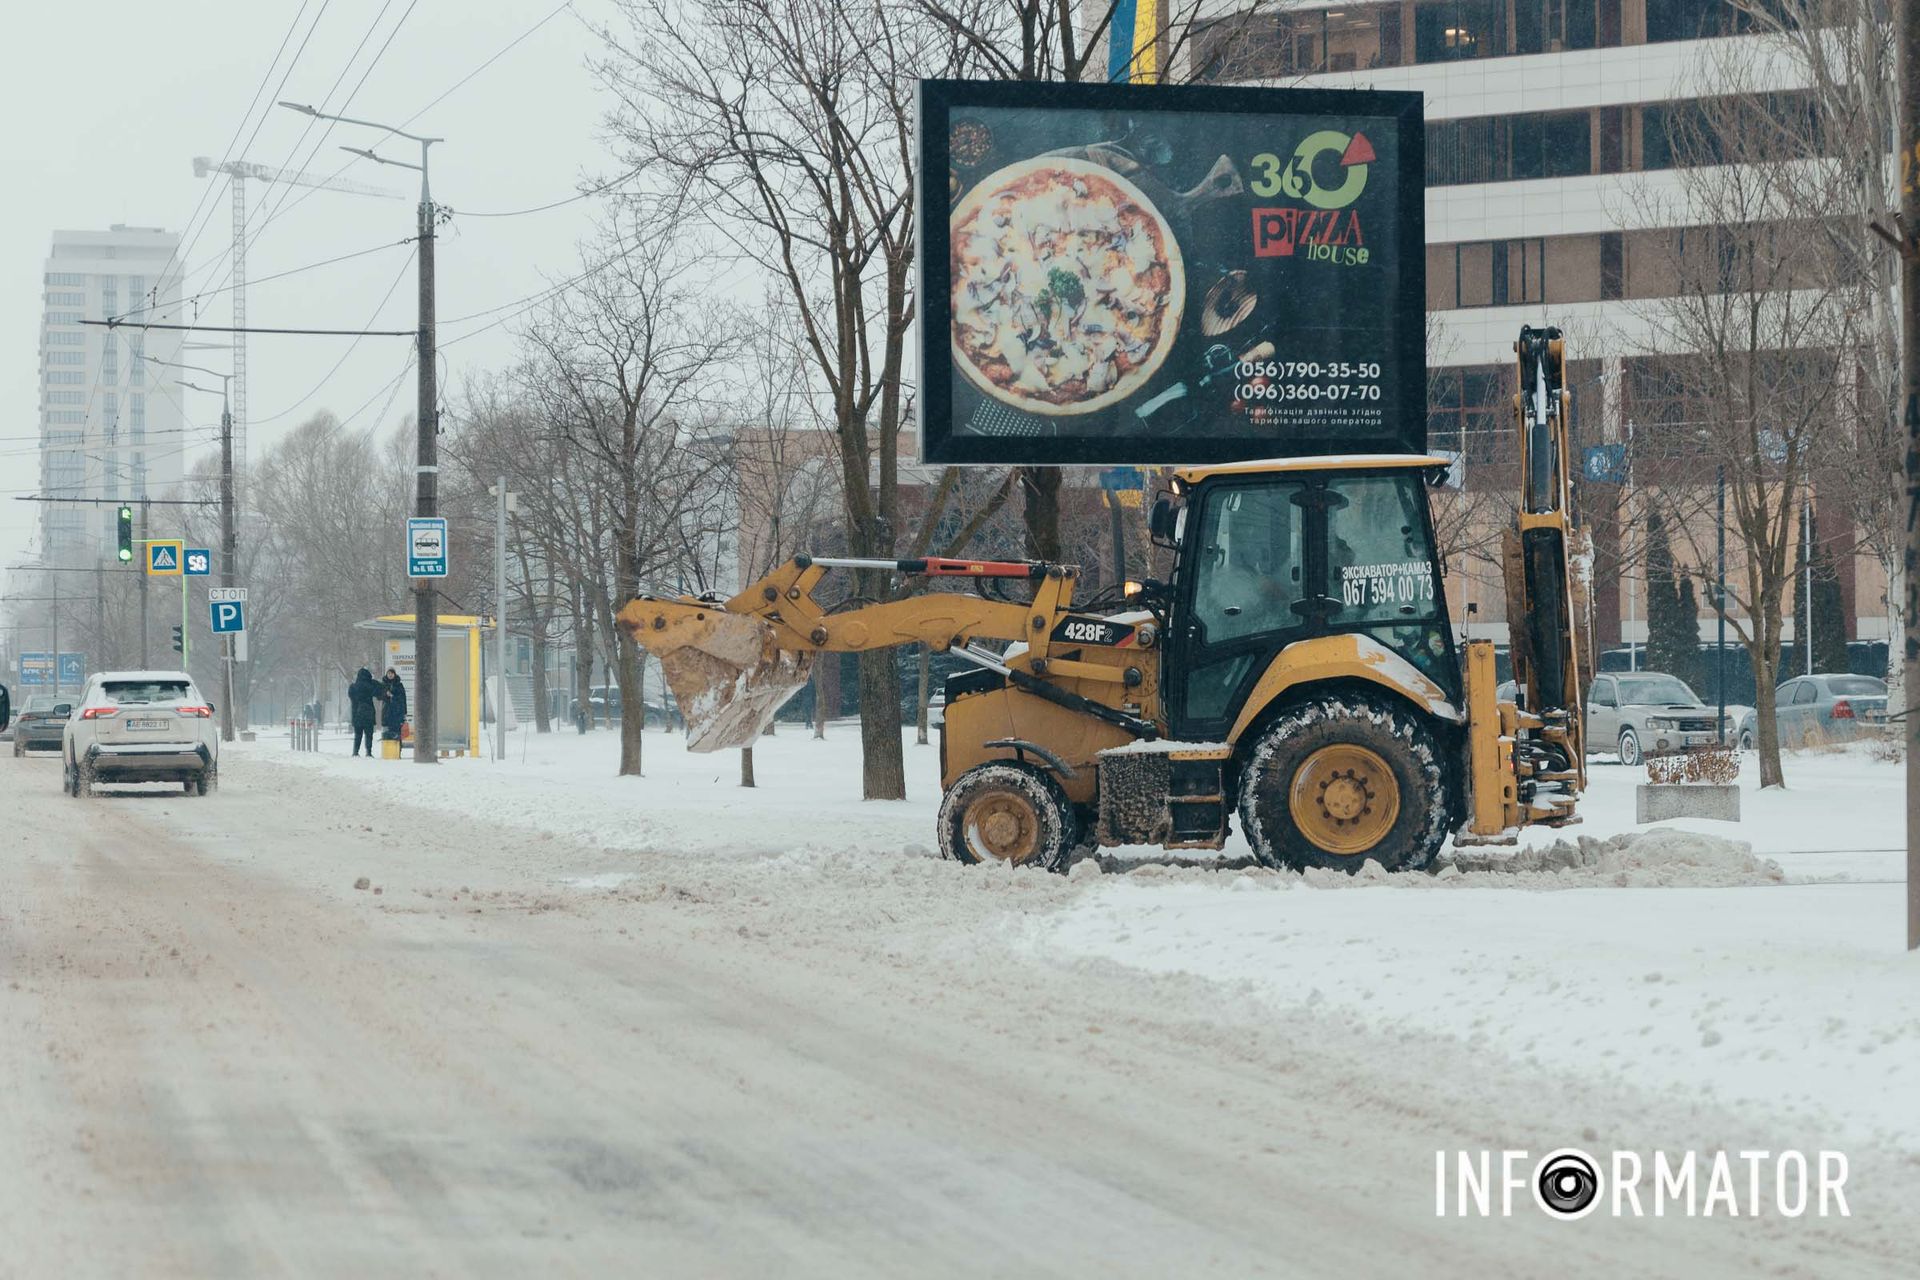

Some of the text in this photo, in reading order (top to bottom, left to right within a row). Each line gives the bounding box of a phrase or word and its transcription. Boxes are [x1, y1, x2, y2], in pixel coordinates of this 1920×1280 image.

[1250, 130, 1376, 209] 360
[1234, 361, 1381, 380] (056)790-35-50
[1234, 384, 1381, 402] (096)360-07-70
[1244, 407, 1382, 416] Тарифікація дзвінків згідно
[1249, 417, 1289, 426] тарифів
[1330, 418, 1382, 426] оператора
[1342, 561, 1433, 580] ЭКСКАВАТОР+КАМАЗ
[210, 589, 246, 600] СТОП
[1343, 574, 1434, 607] 067 594 00 73
[218, 604, 237, 629] P
